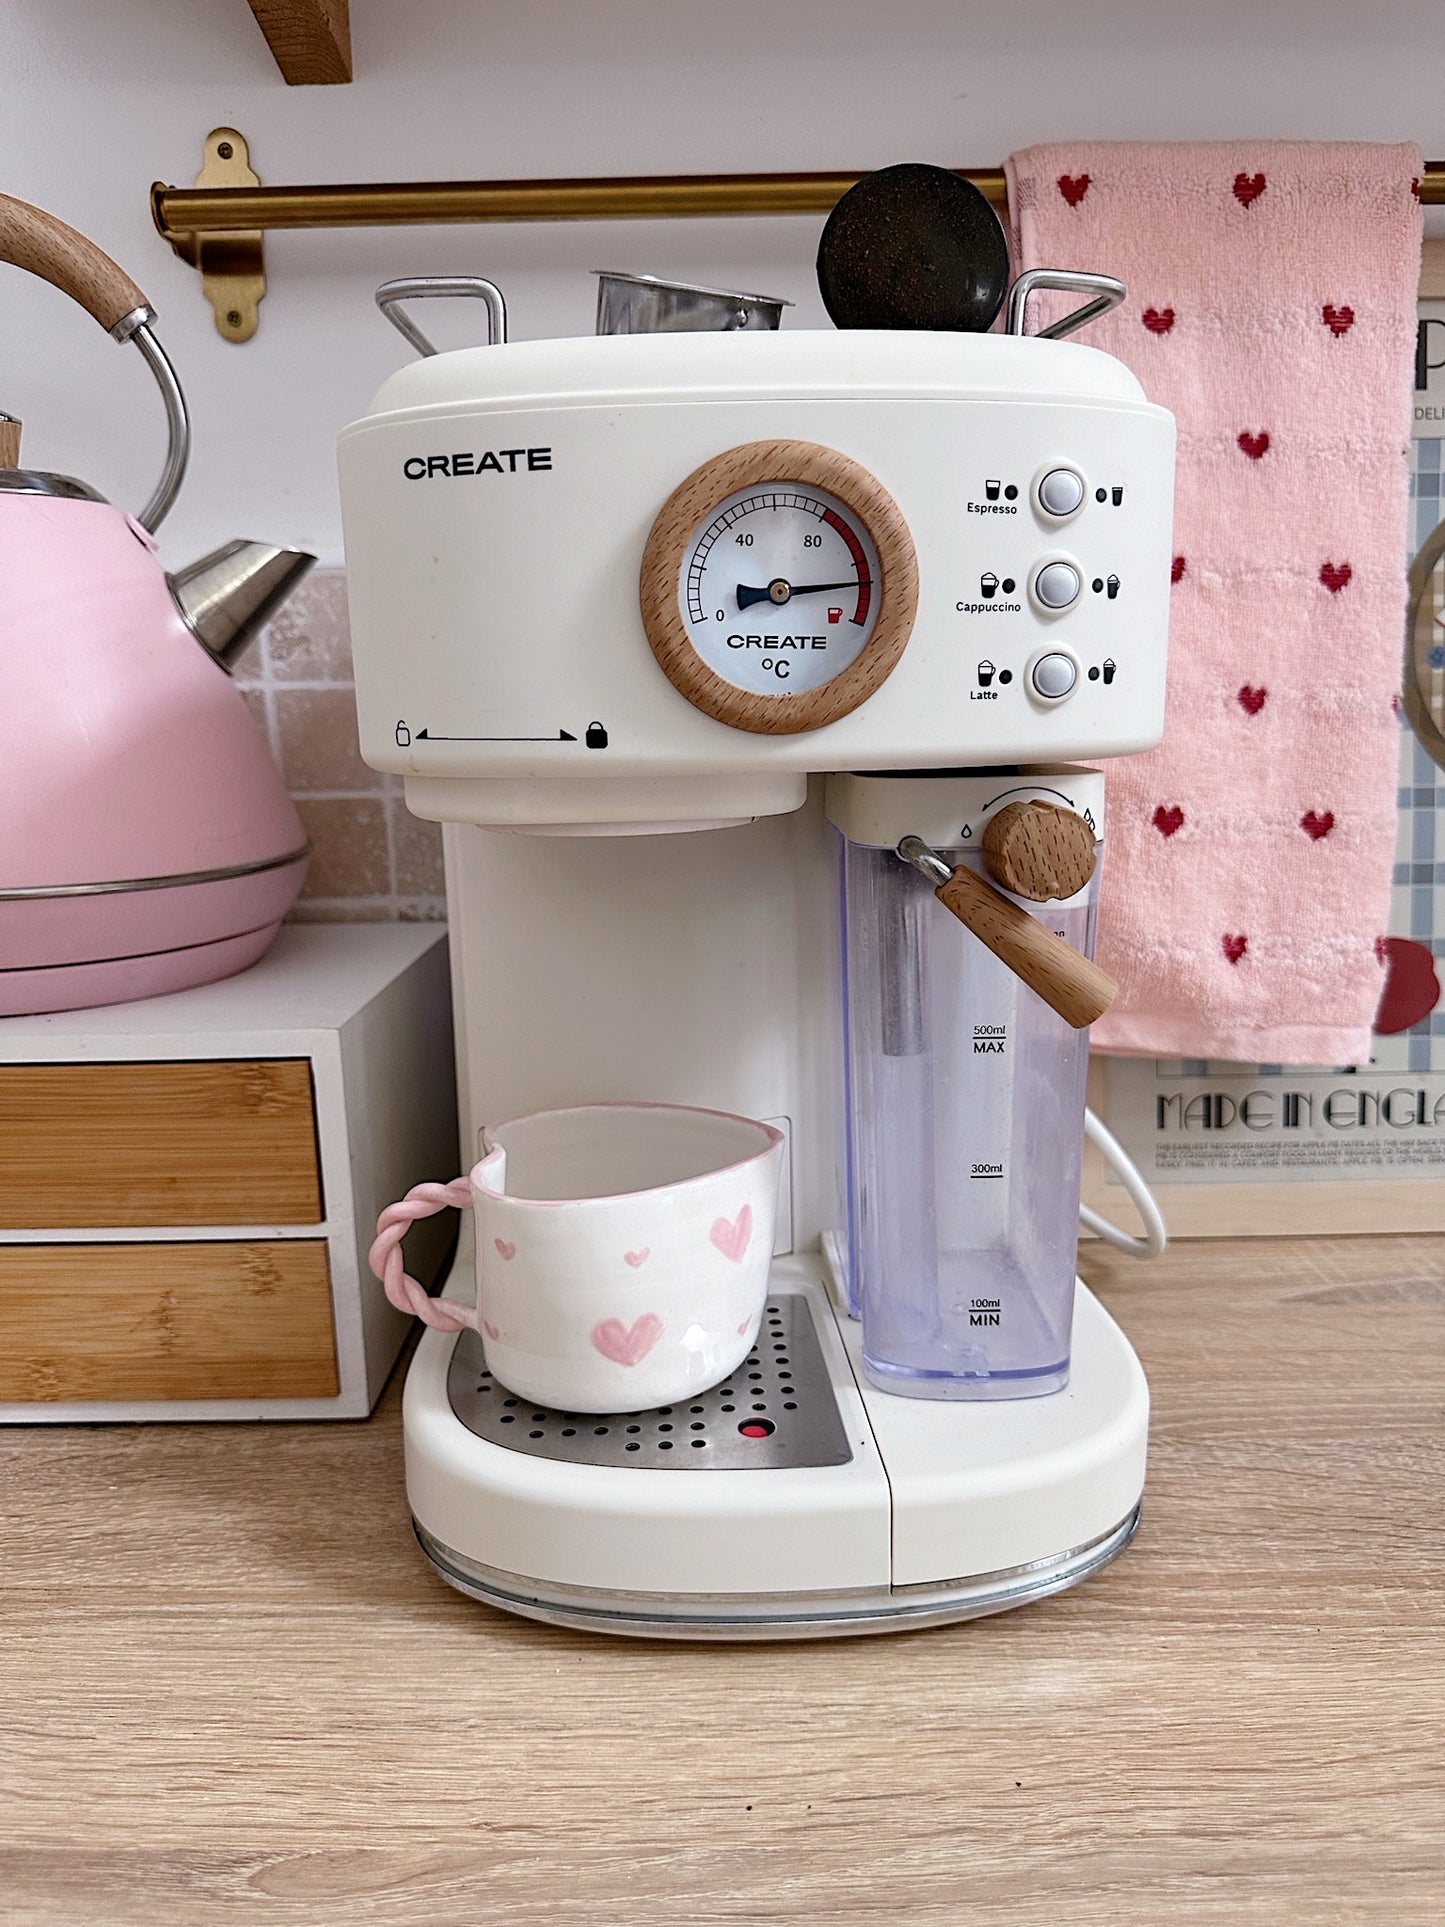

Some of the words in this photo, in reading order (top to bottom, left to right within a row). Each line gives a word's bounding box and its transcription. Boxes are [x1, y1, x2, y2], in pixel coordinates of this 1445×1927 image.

[403, 447, 552, 480] CREATE
[967, 502, 1018, 515] Espresso
[735, 533, 754, 547] 40
[803, 534, 822, 548] 80
[956, 602, 1021, 614] Cappuccino
[715, 609, 725, 622] 0
[726, 634, 827, 649] CREATE
[970, 691, 998, 701] Latte
[973, 1025, 1006, 1036] 500ml
[973, 1042, 1005, 1054] MAX
[1157, 1090, 1274, 1132] MADE
[1282, 1092, 1313, 1128] IN
[971, 1164, 1003, 1173] 300ml
[970, 1299, 1000, 1308] 100ml
[969, 1314, 1000, 1326] MIN
